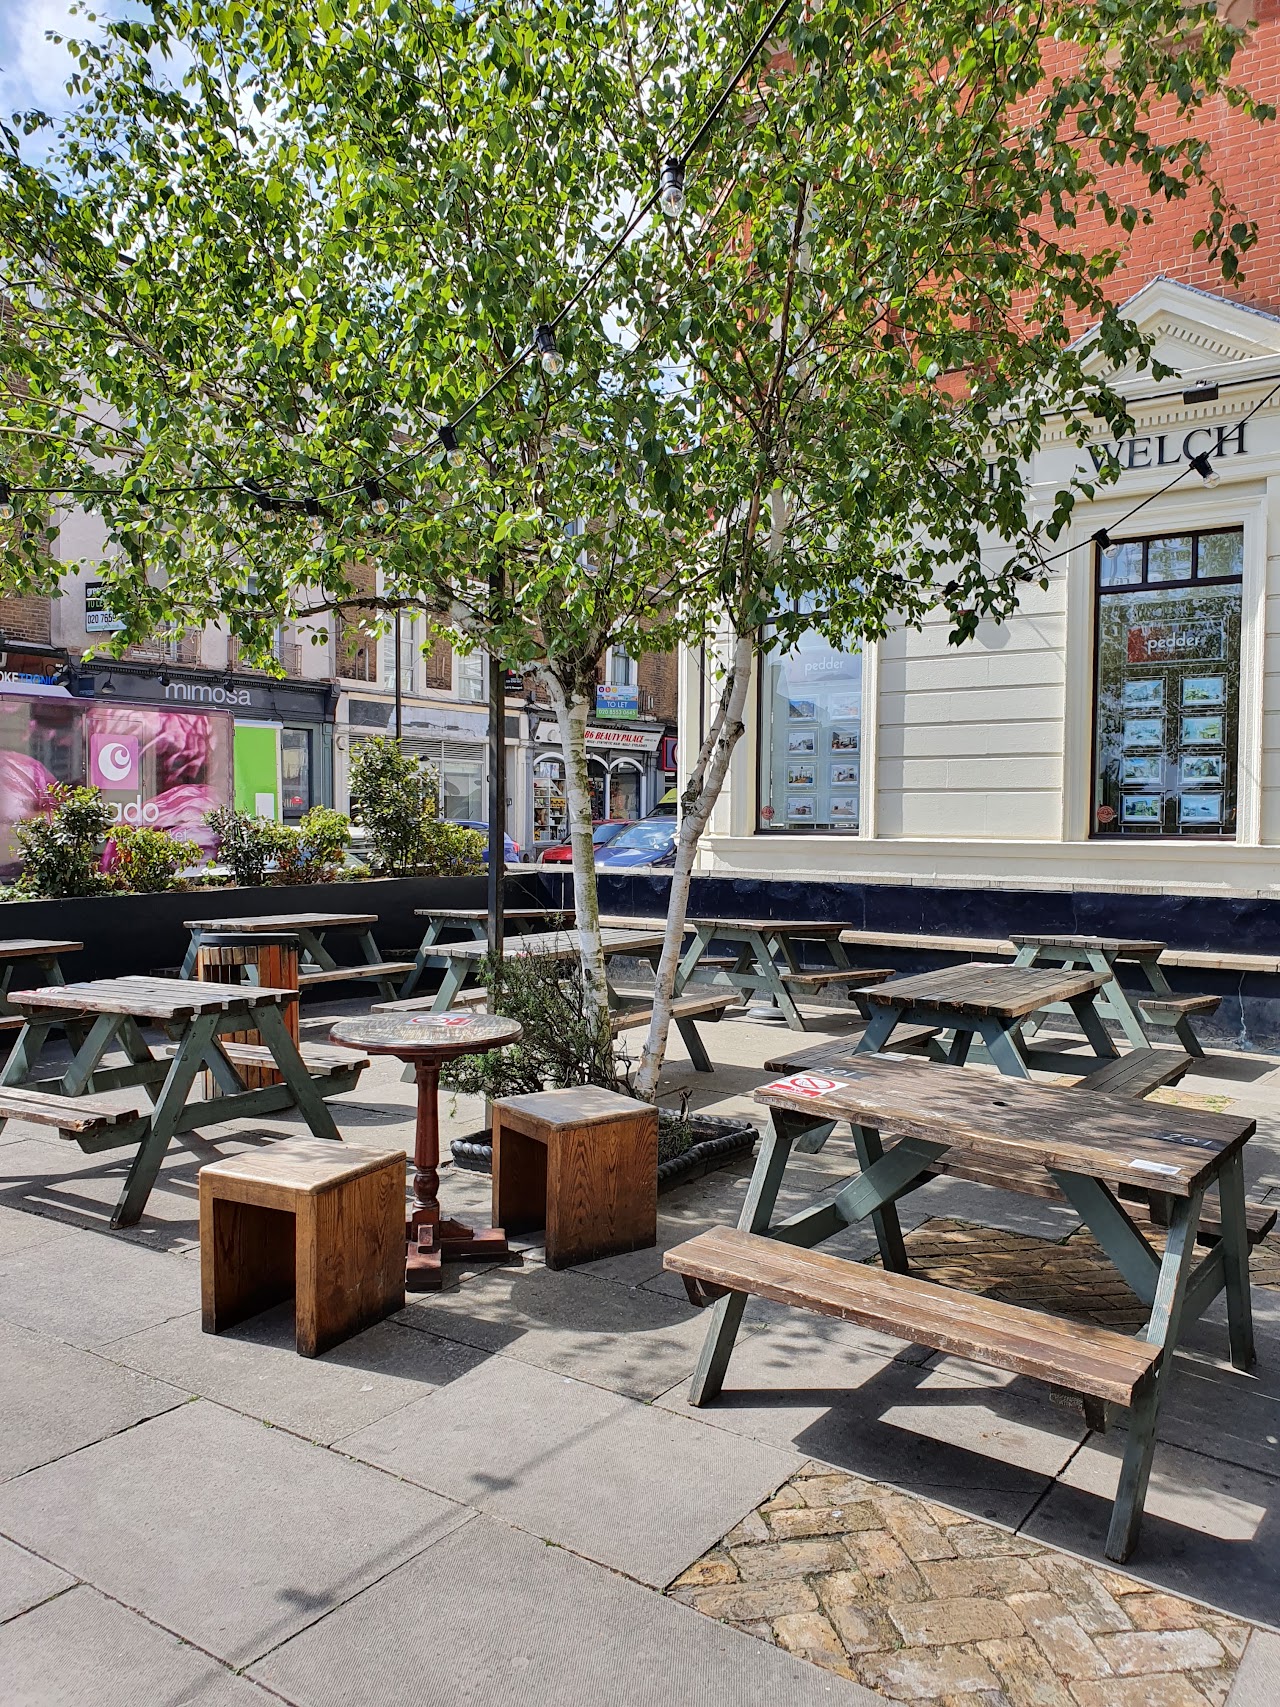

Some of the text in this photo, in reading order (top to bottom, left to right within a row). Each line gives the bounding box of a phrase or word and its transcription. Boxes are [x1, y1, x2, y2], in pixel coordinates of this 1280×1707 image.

[1085, 422, 1248, 473] WELCH
[87, 614, 99, 624] 020
[1147, 631, 1200, 654] pedder
[804, 656, 844, 677] pedder
[165, 682, 252, 706] mimosa
[595, 731, 621, 741] BEAUTY
[620, 733, 645, 743] PALACE
[103, 794, 159, 823] ado
[815, 1065, 858, 1078] 201
[1163, 1132, 1213, 1146] 201
